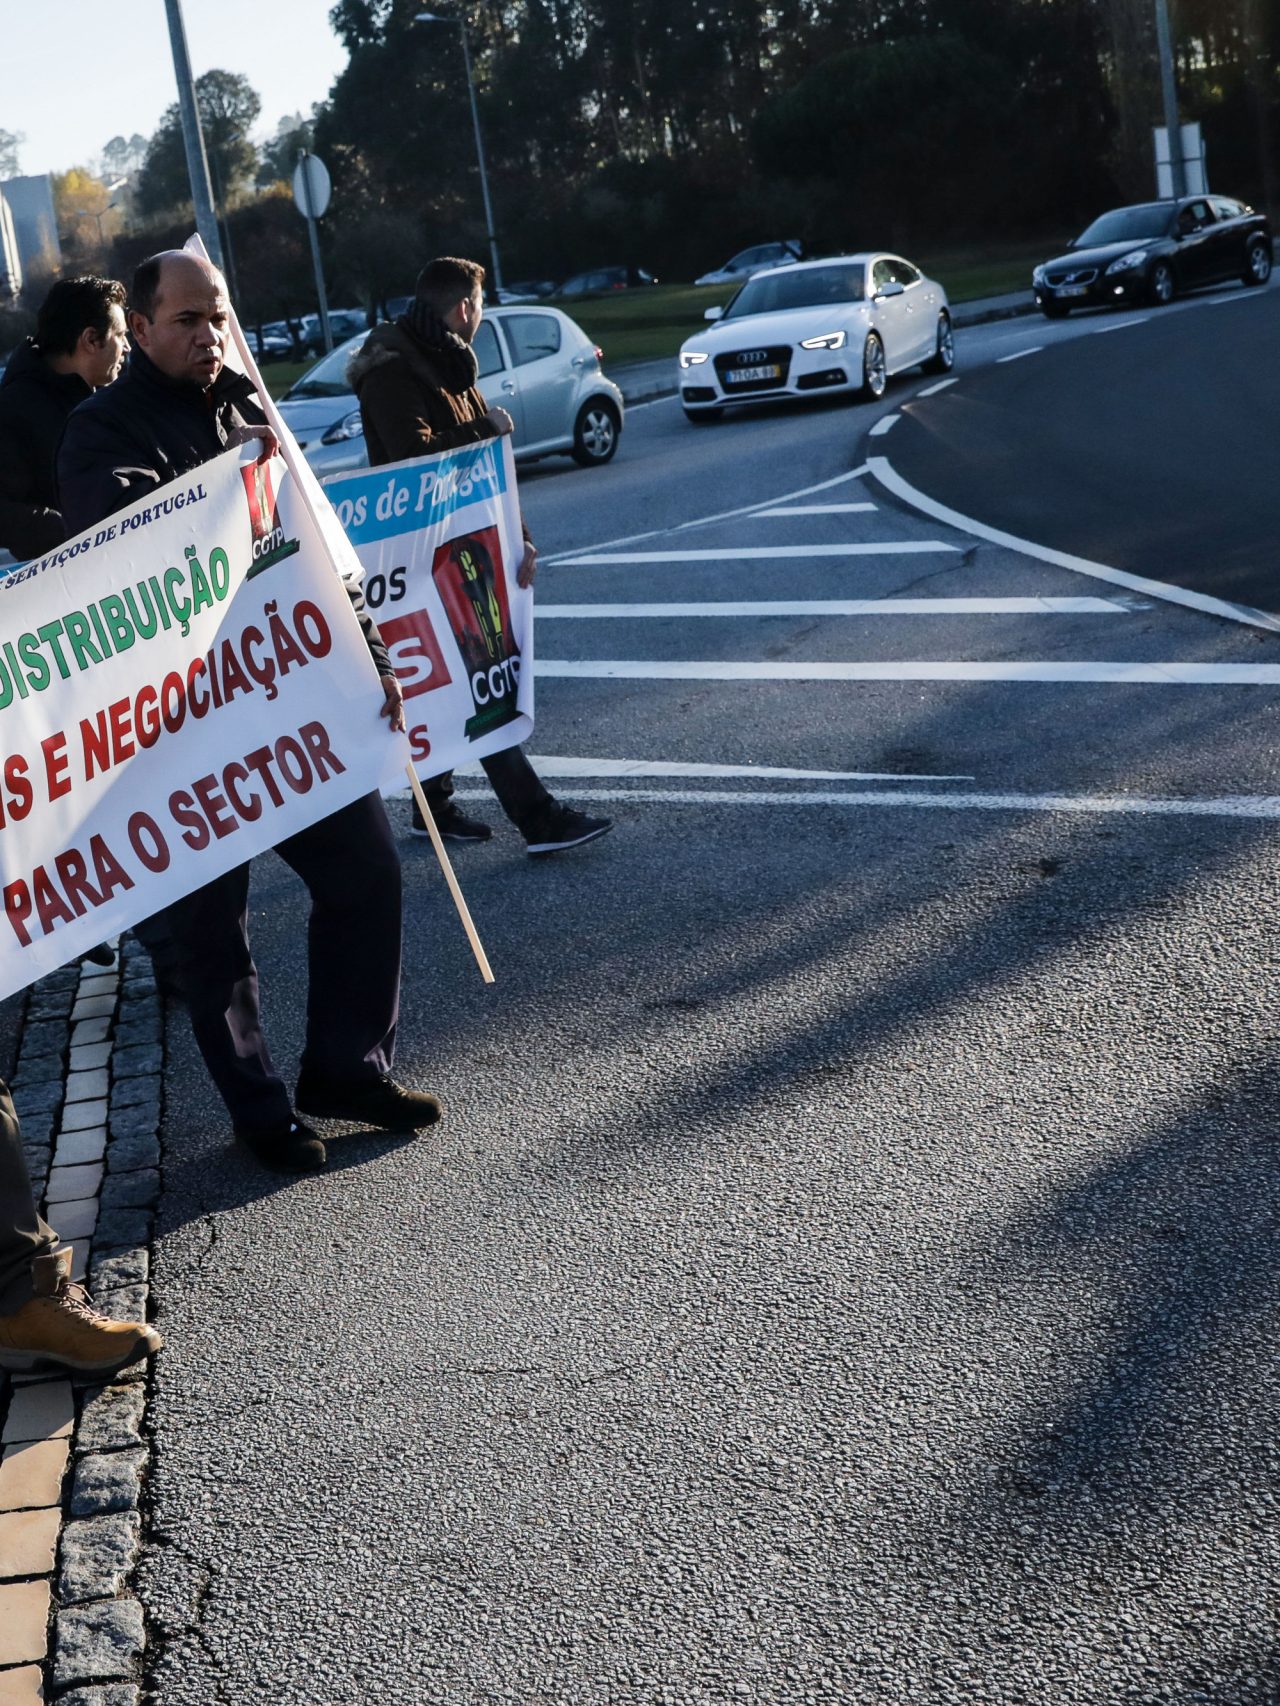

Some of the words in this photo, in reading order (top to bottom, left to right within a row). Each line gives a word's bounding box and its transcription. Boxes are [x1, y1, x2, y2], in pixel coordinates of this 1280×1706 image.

[5, 537, 90, 590] SERVIÇOS
[94, 524, 117, 548] DE
[120, 484, 207, 535] PORTUGAL
[330, 494, 368, 528] os
[376, 478, 410, 521] de
[253, 526, 284, 560] CGTP
[41, 732, 72, 802] E
[80, 598, 332, 781] NEGOCIAÇÃO
[471, 655, 521, 705] CGTP
[3, 833, 136, 947] PARA
[128, 811, 170, 873] O
[169, 721, 347, 851] SECTOR
